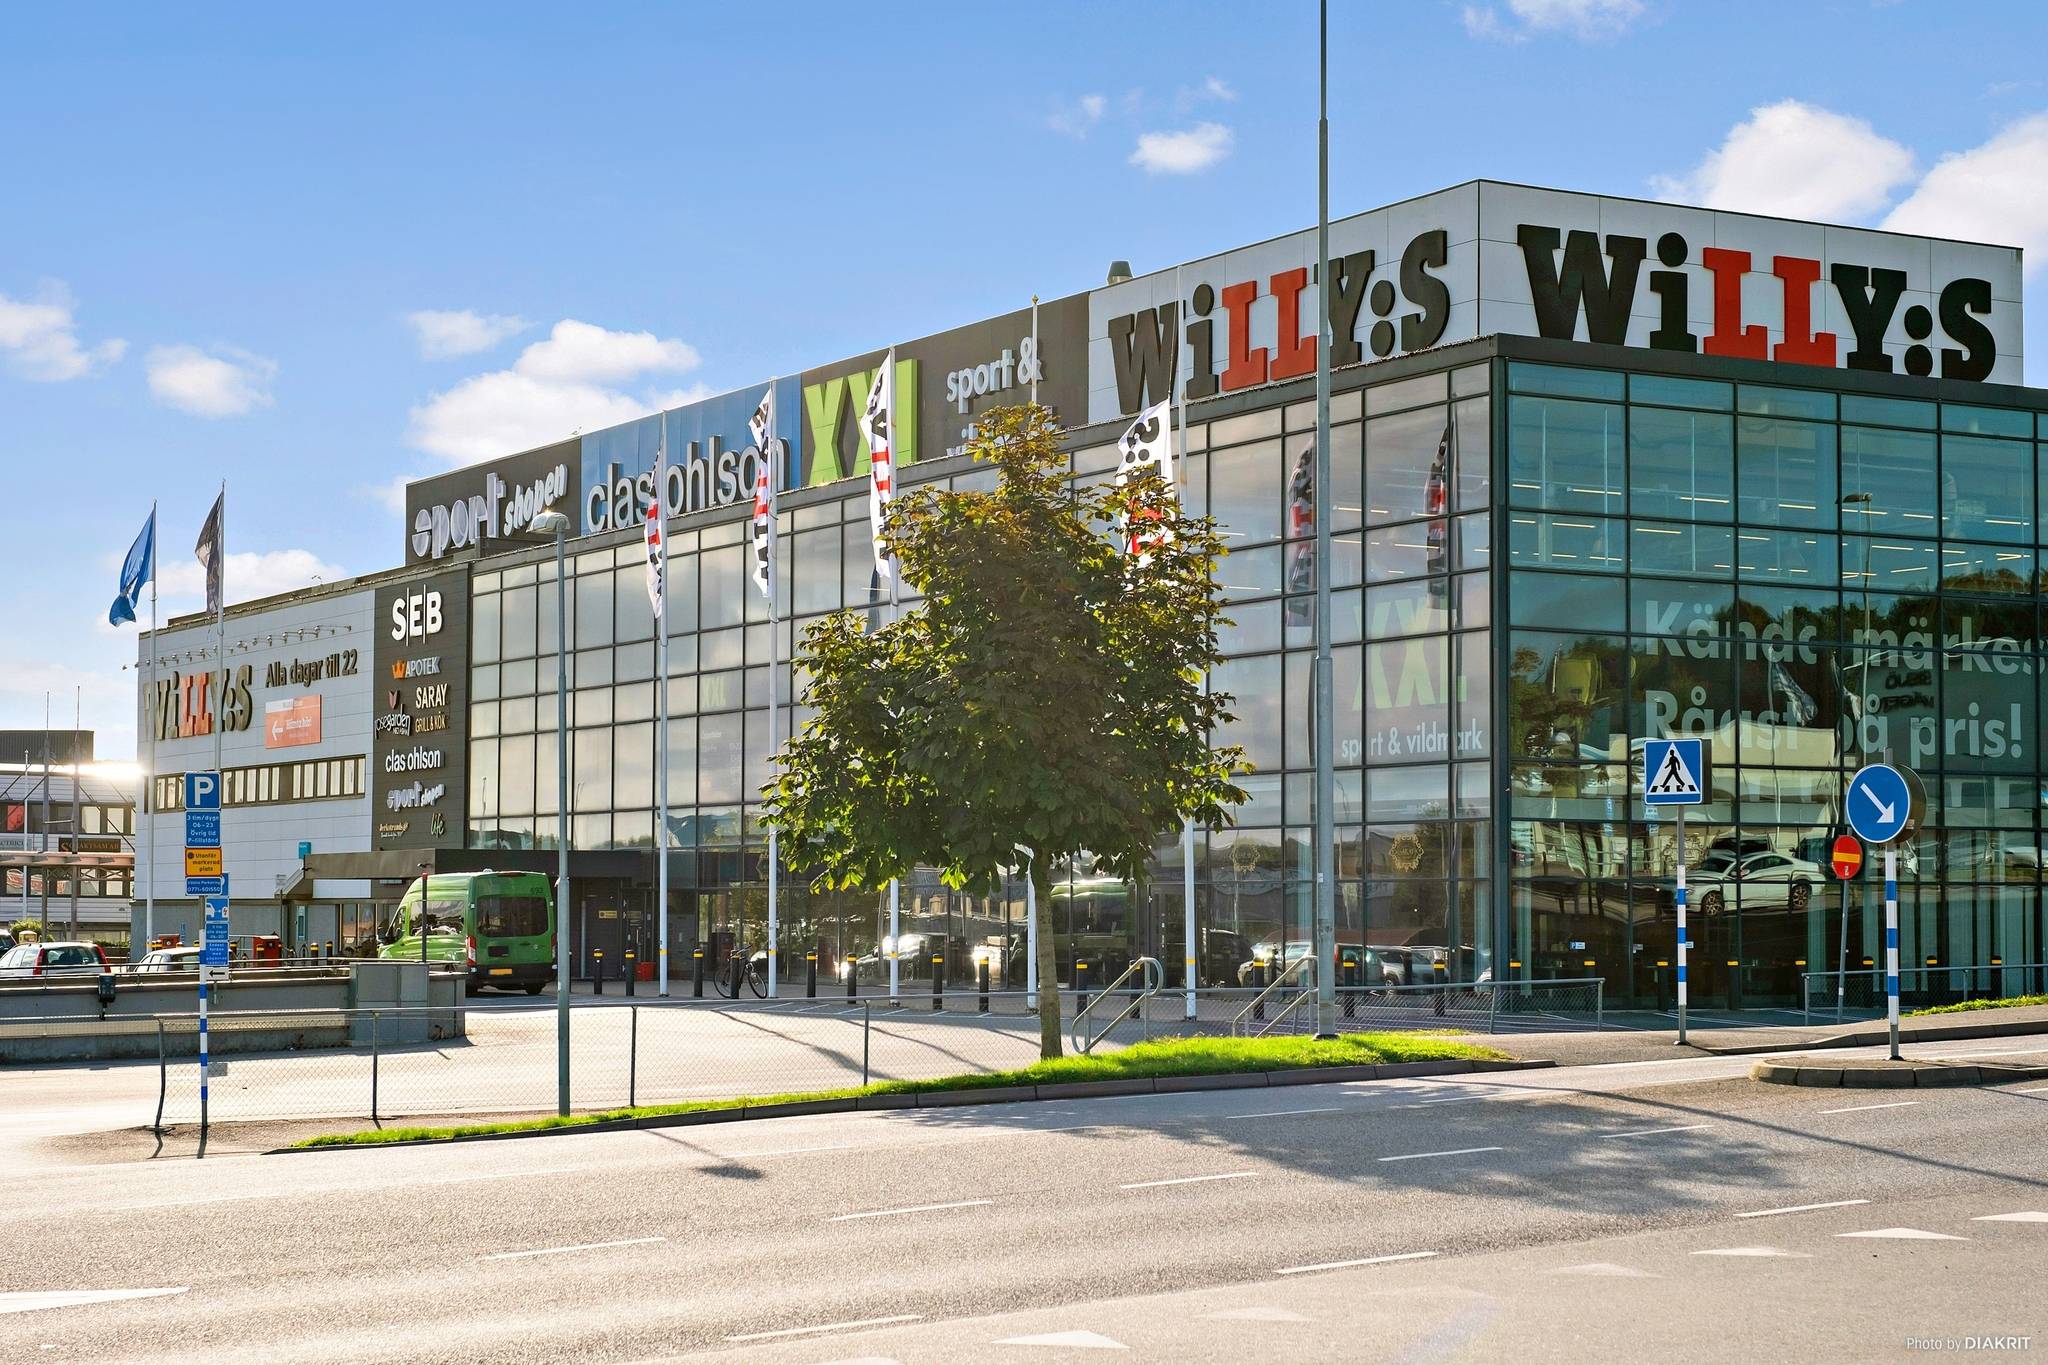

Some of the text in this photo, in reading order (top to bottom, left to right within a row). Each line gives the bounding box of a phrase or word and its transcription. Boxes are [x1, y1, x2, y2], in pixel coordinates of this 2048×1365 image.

[946, 336, 1044, 414] sport &
[587, 463, 654, 532] clas
[392, 588, 443, 643] SEB
[265, 648, 359, 688] Alla dagar till 22
[405, 656, 441, 678] APOTEK
[415, 683, 448, 710] SARAY
[415, 715, 430, 733] GRILL
[1910, 702, 2023, 769] pris!
[1388, 726, 1401, 756] &
[385, 745, 441, 772] clas ohlson
[194, 776, 215, 806] P
